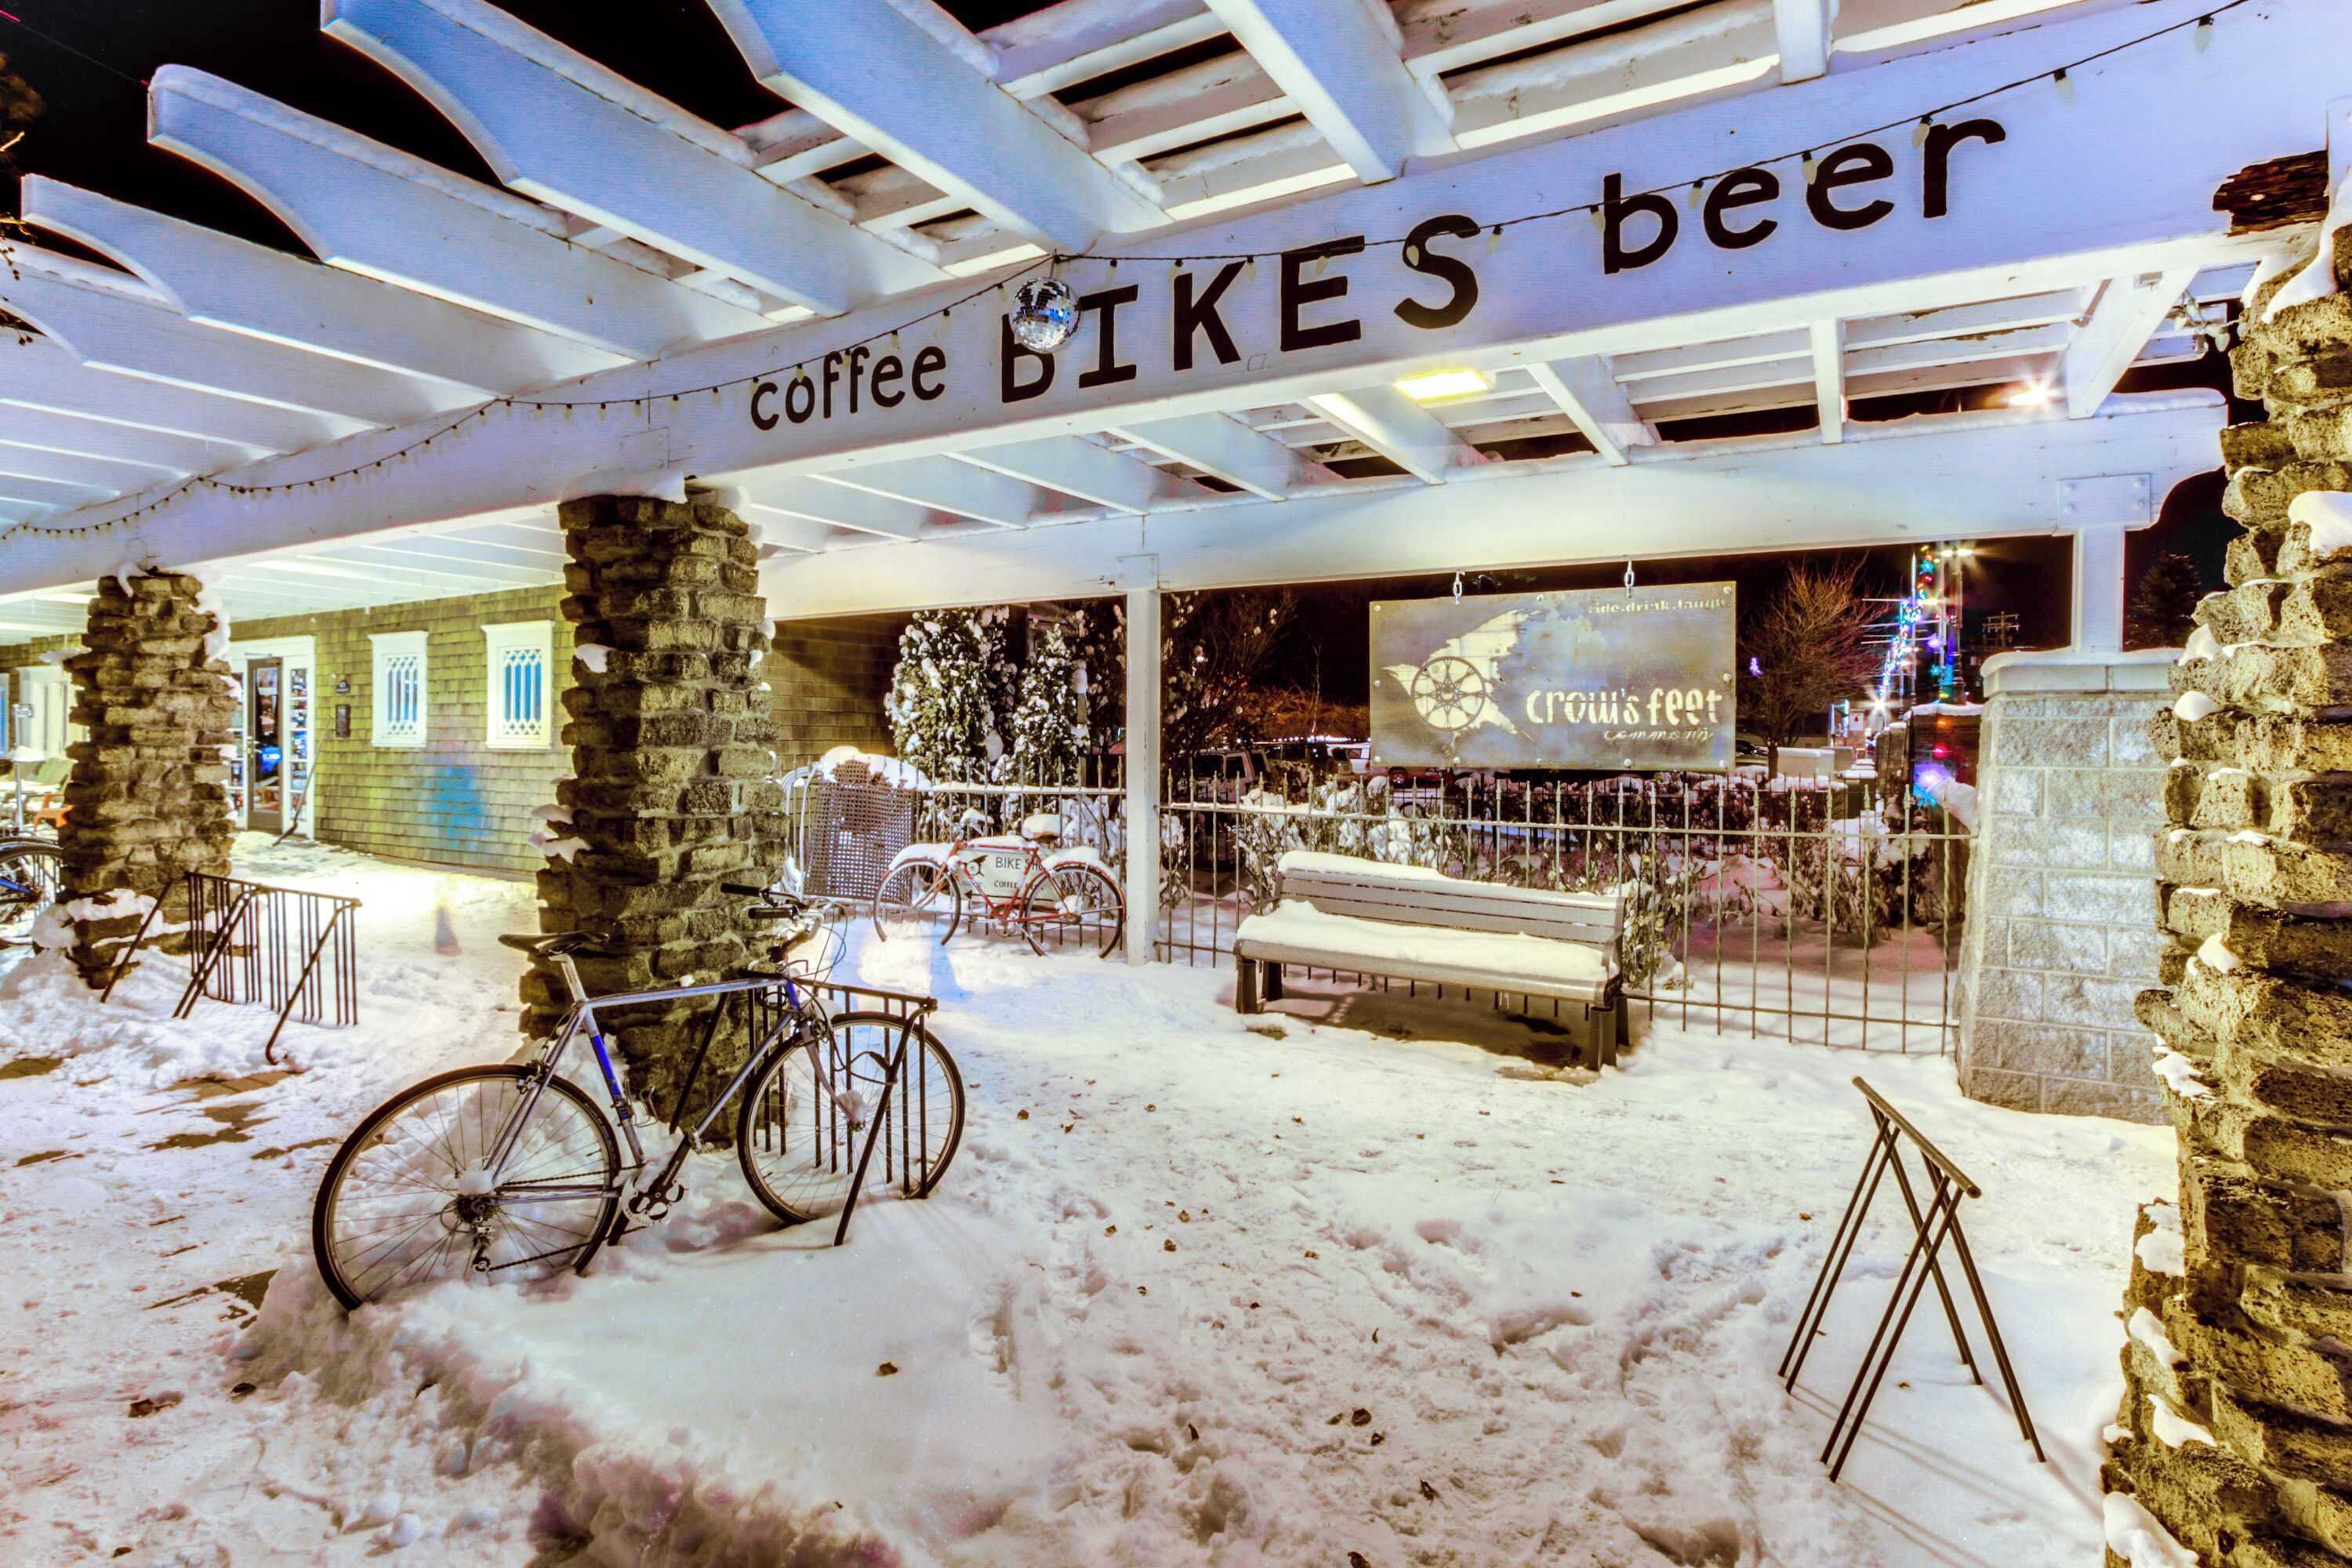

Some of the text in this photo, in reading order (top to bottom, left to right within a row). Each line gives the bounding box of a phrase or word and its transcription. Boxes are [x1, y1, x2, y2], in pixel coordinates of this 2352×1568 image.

[750, 118, 2006, 431] coffee BIKES beer
[1526, 688, 1722, 725] crow's feet
[996, 856, 1022, 870] BIKE
